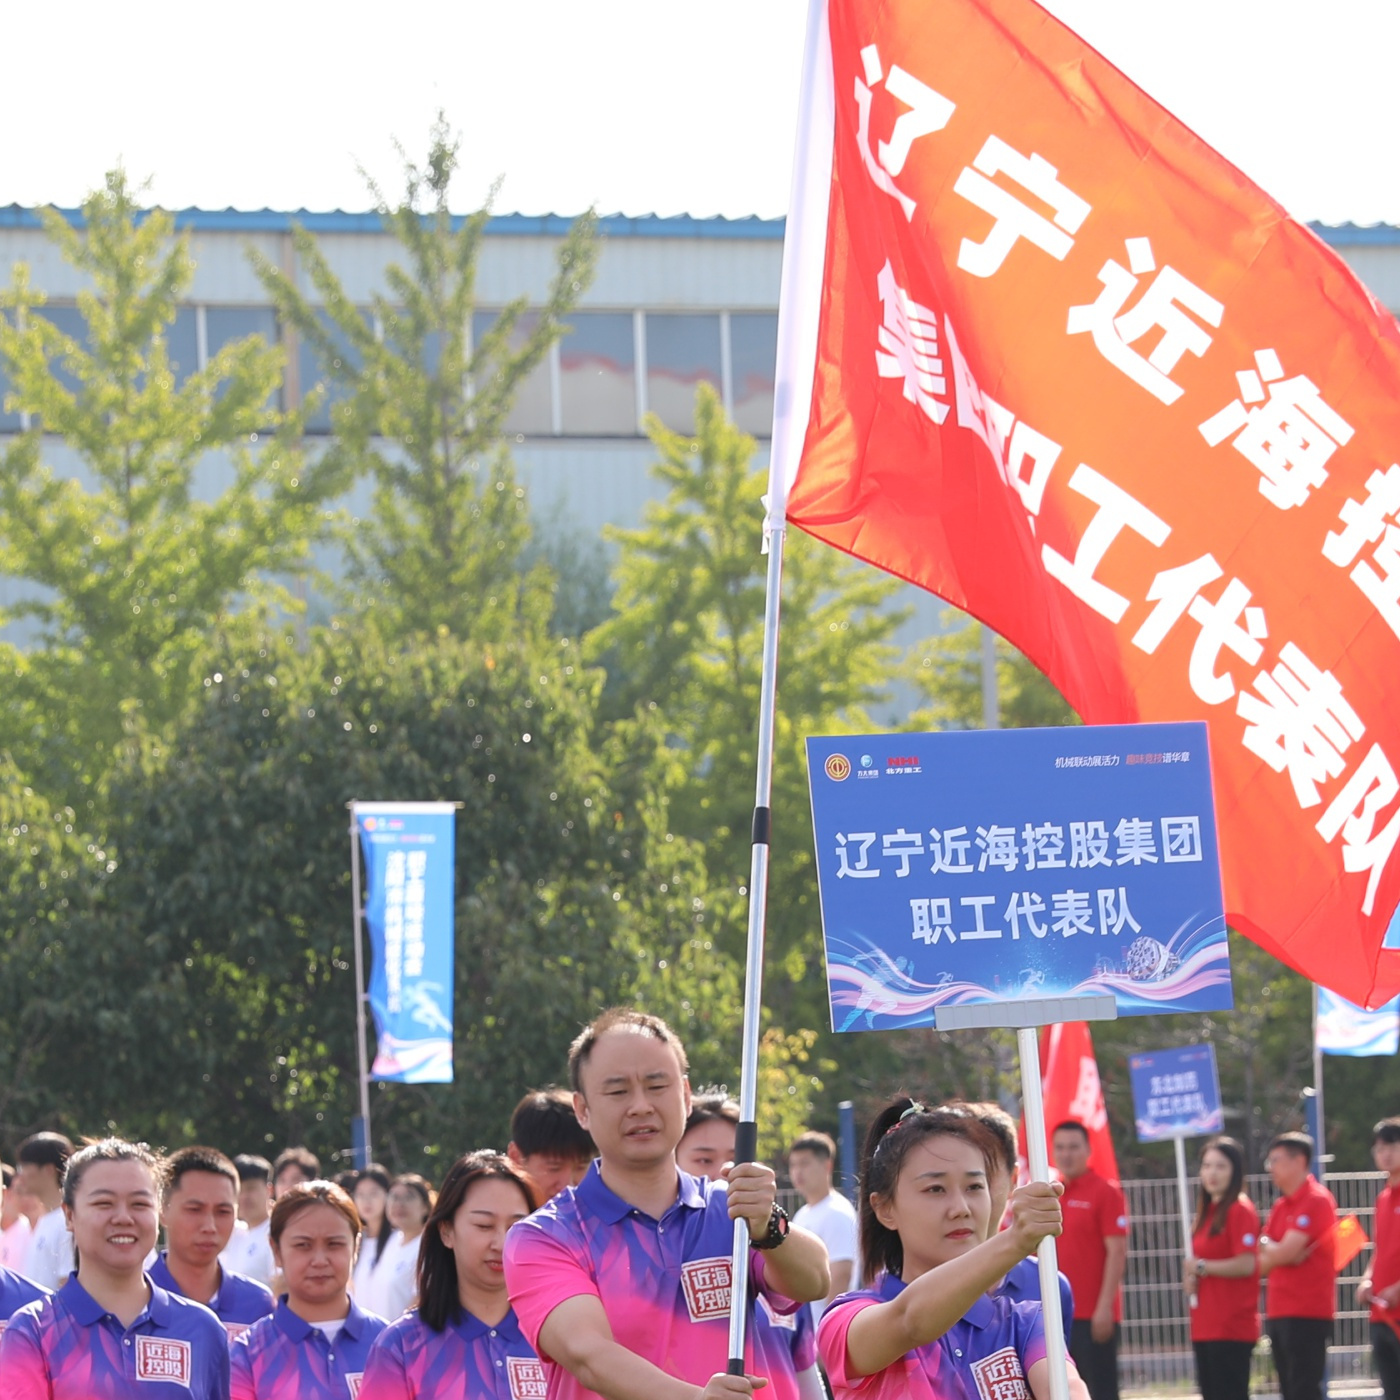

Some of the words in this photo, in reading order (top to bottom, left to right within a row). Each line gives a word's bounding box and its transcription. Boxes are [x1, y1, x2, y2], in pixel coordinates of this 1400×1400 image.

[886, 767, 922, 775] 北方重工
[1055, 754, 1120, 768] 机械联动展活力
[835, 815, 1203, 880] 辽宁近海控股集团
[910, 887, 1141, 945] 职工代表队
[691, 1266, 730, 1290] 近海
[695, 1287, 732, 1312] 控股
[145, 1343, 180, 1361] 近海
[146, 1358, 183, 1378] 控股
